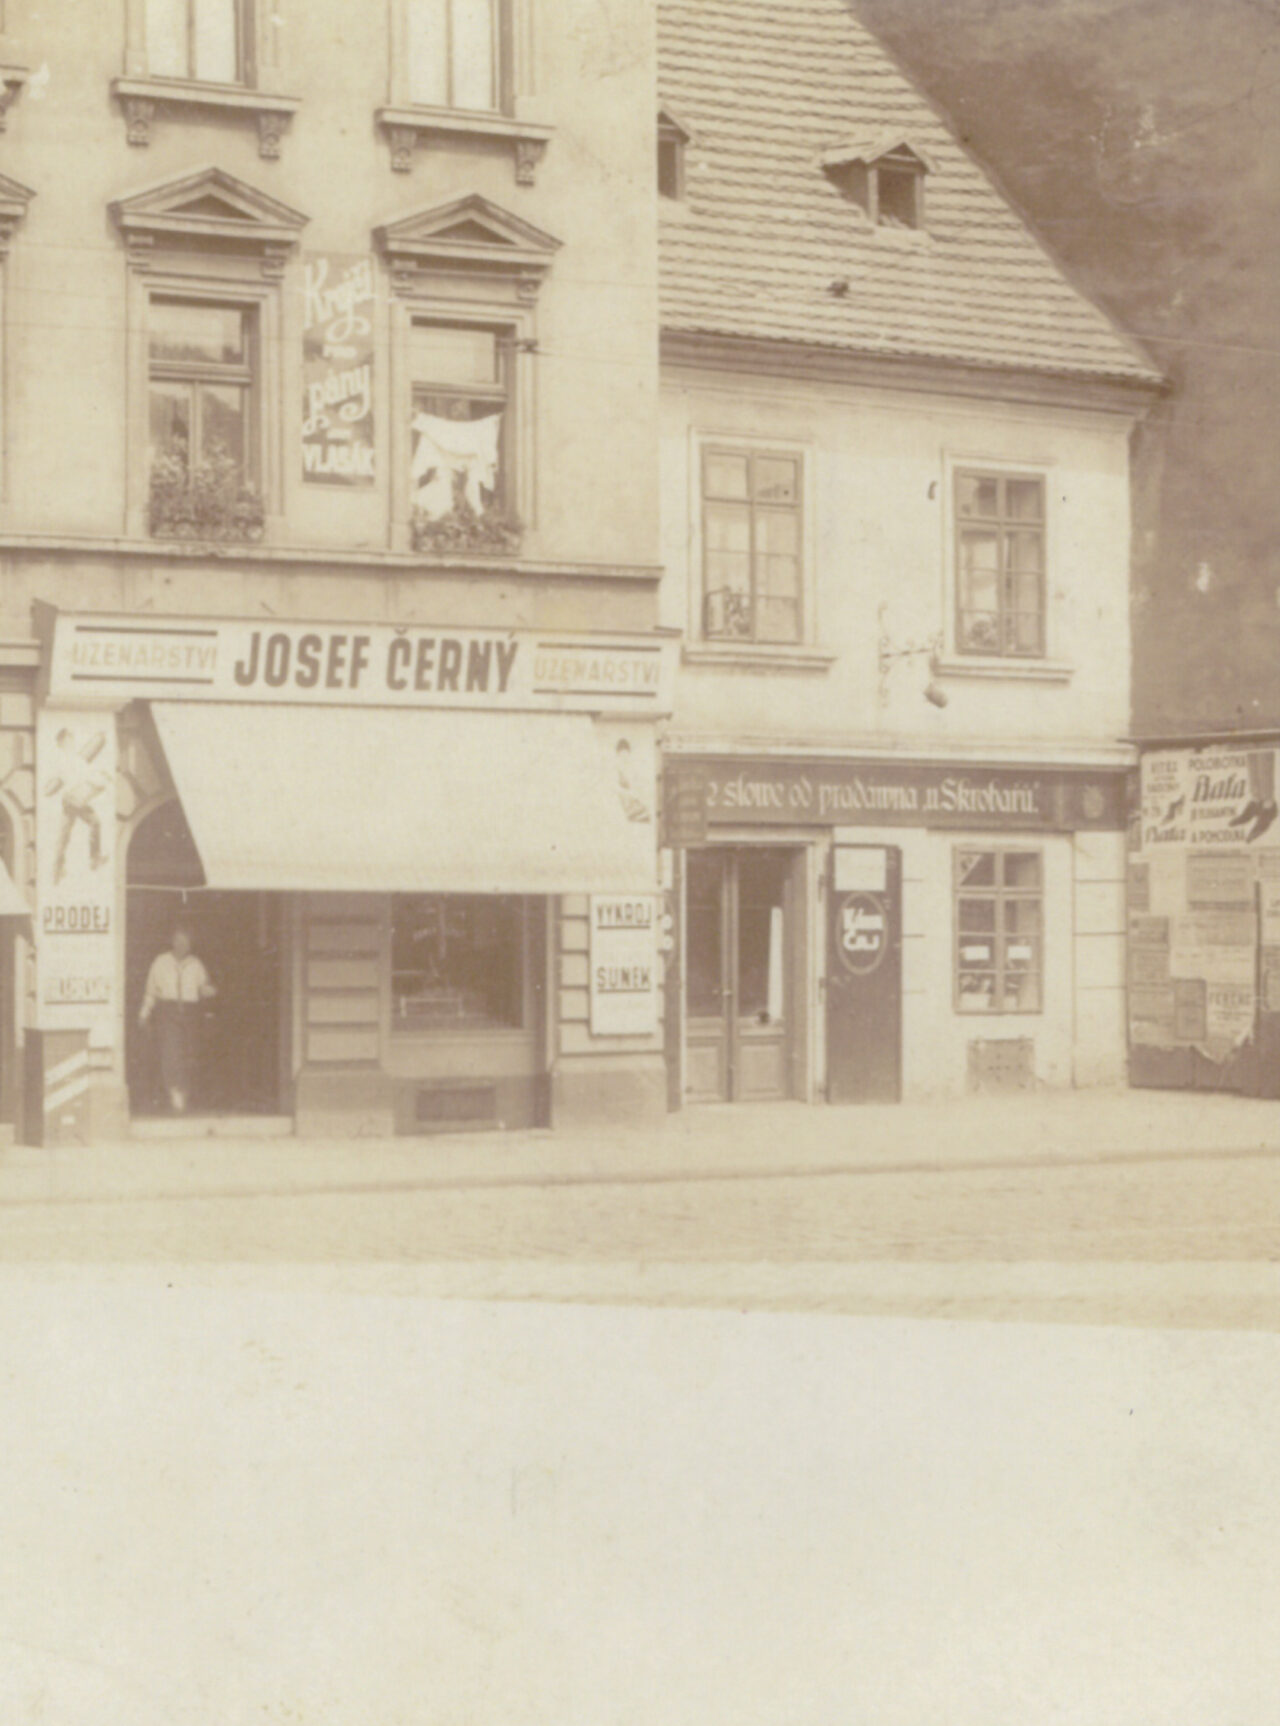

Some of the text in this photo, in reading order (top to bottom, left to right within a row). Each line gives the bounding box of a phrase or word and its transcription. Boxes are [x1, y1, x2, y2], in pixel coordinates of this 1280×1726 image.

[234, 628, 519, 693] JOSEF ČERNÝ
[788, 774, 813, 808] od
[43, 905, 110, 930] PRODEJ
